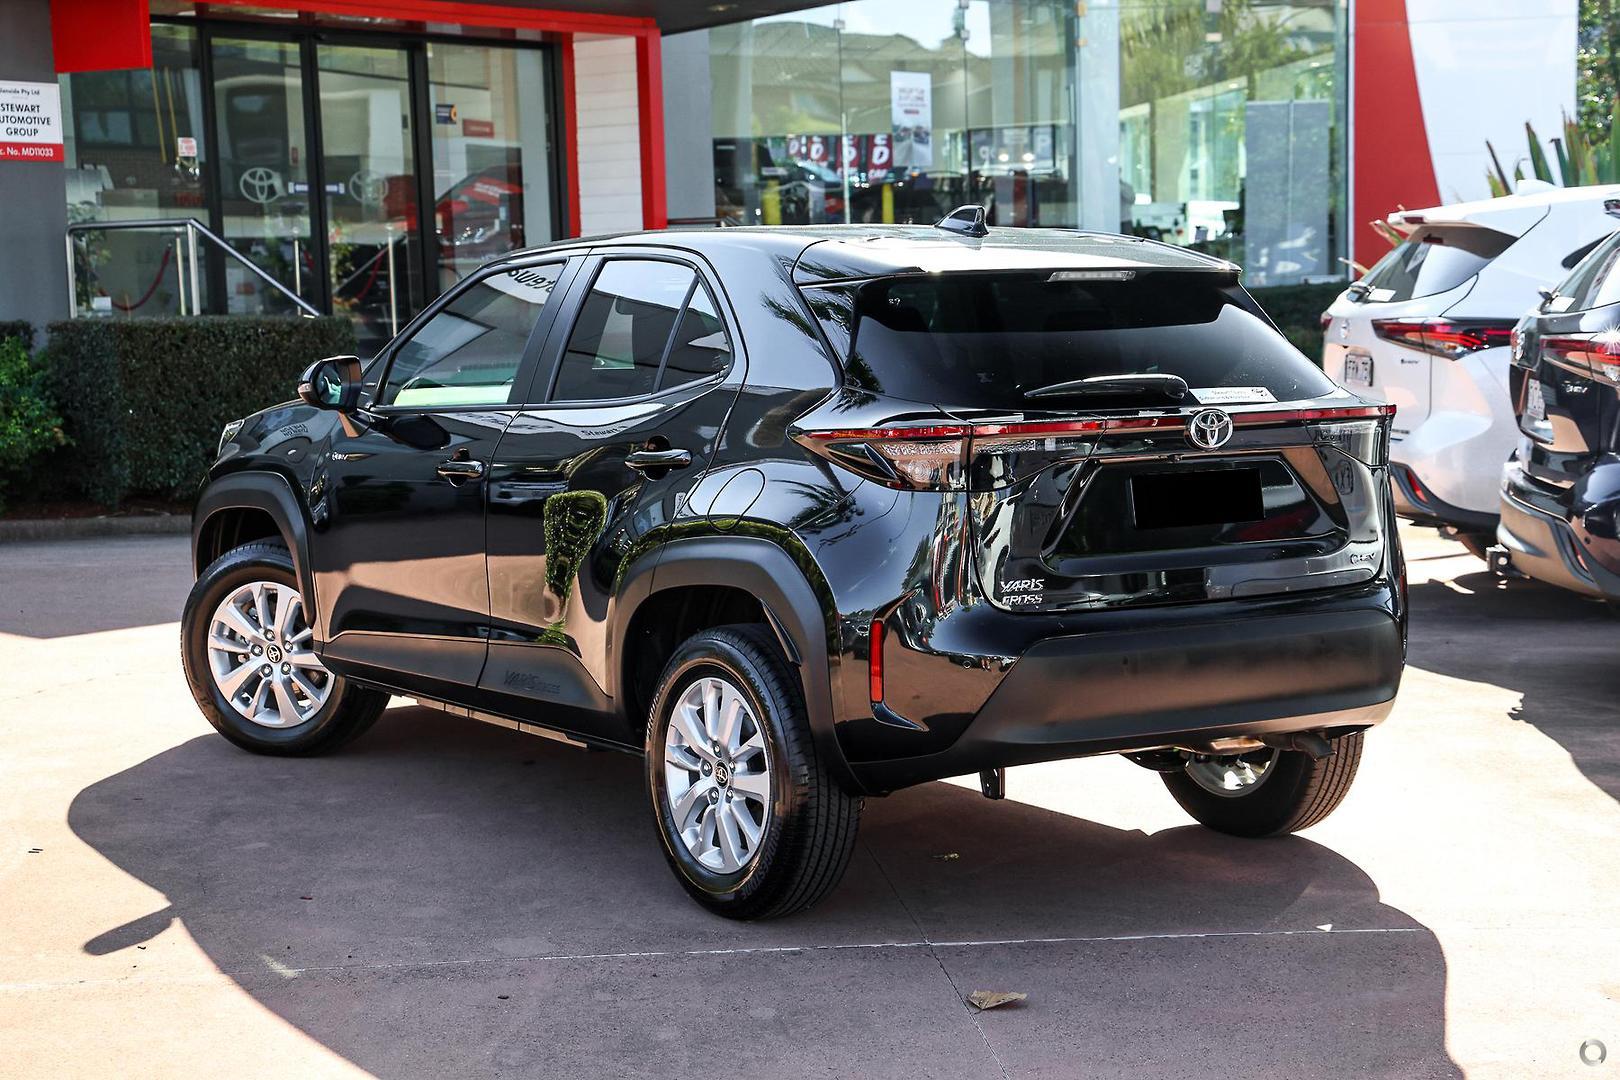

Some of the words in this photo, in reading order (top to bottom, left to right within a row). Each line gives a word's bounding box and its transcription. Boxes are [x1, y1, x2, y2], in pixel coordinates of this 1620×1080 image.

[0, 103, 40, 113] STEWART
[5, 127, 39, 137] GROUP
[6, 146, 20, 156] No.
[1000, 578, 1045, 593] YARIS
[1001, 593, 1043, 606] CROSS
